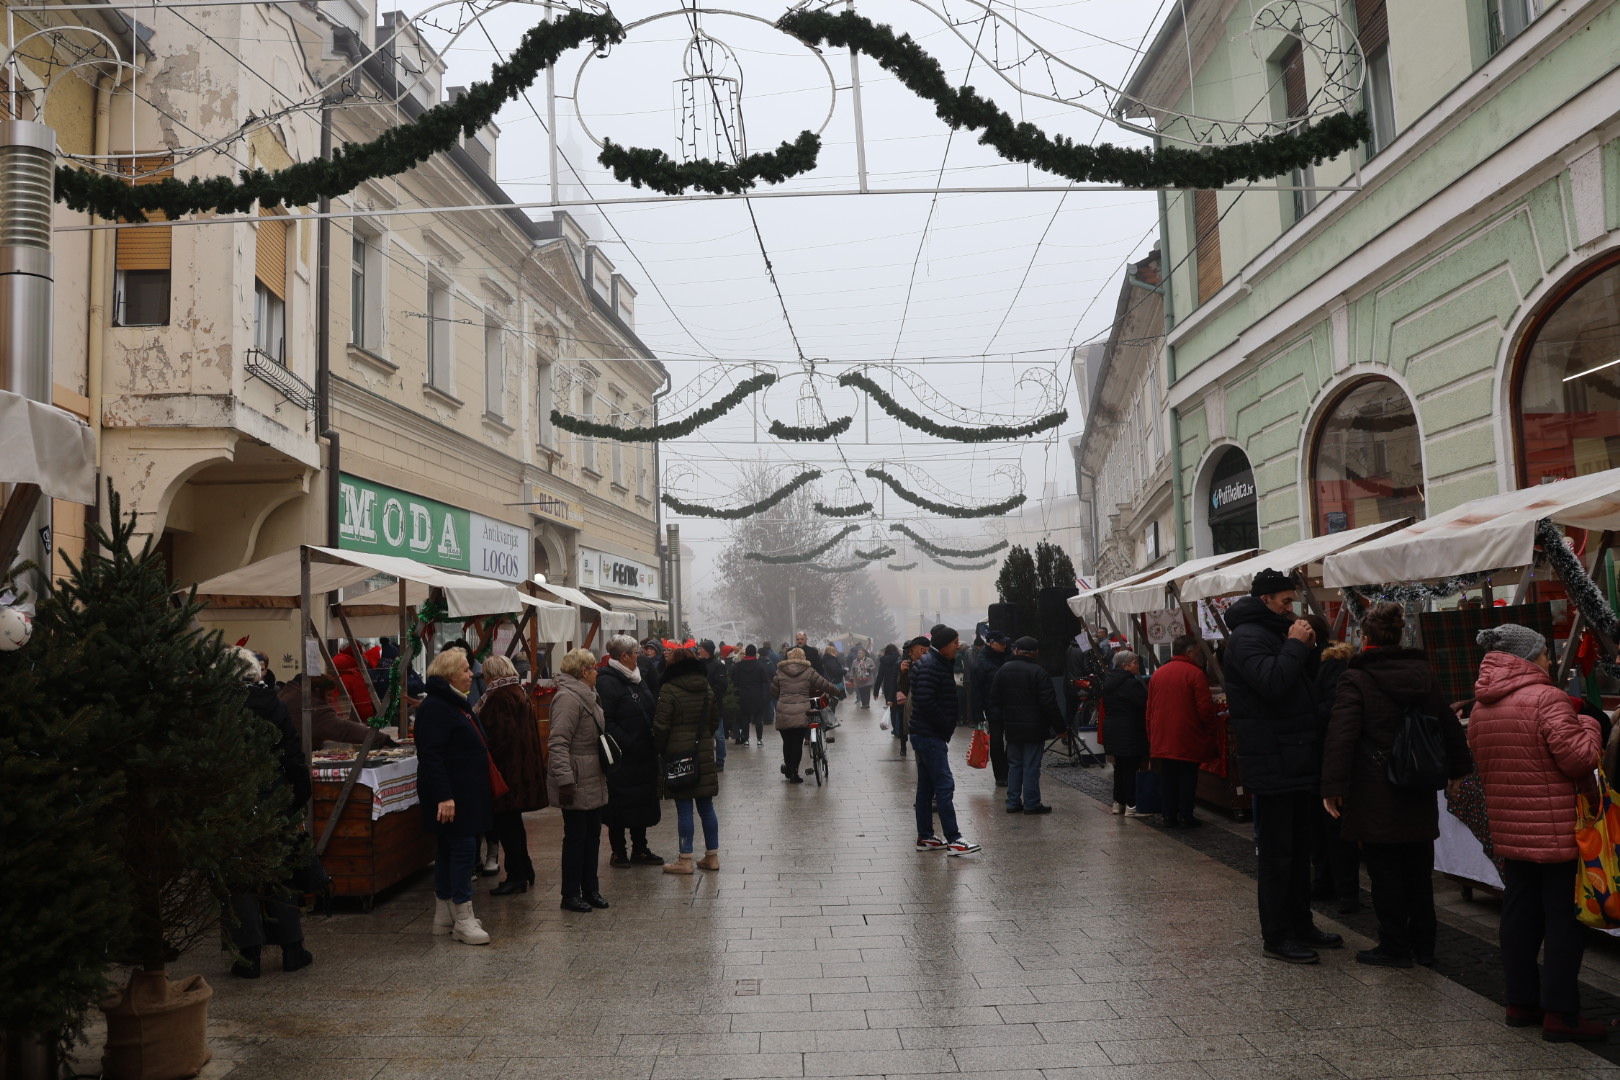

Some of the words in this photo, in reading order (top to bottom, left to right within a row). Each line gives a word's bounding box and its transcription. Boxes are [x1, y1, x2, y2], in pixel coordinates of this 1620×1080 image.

[539, 492, 553, 514] OLD
[554, 498, 570, 520] CITY
[1218, 481, 1254, 506] Puffkalica.hr
[340, 482, 462, 559] MODA
[482, 522, 519, 551] Antikvarijat
[482, 548, 519, 578] LOGOS
[667, 763, 695, 776] Calvin
